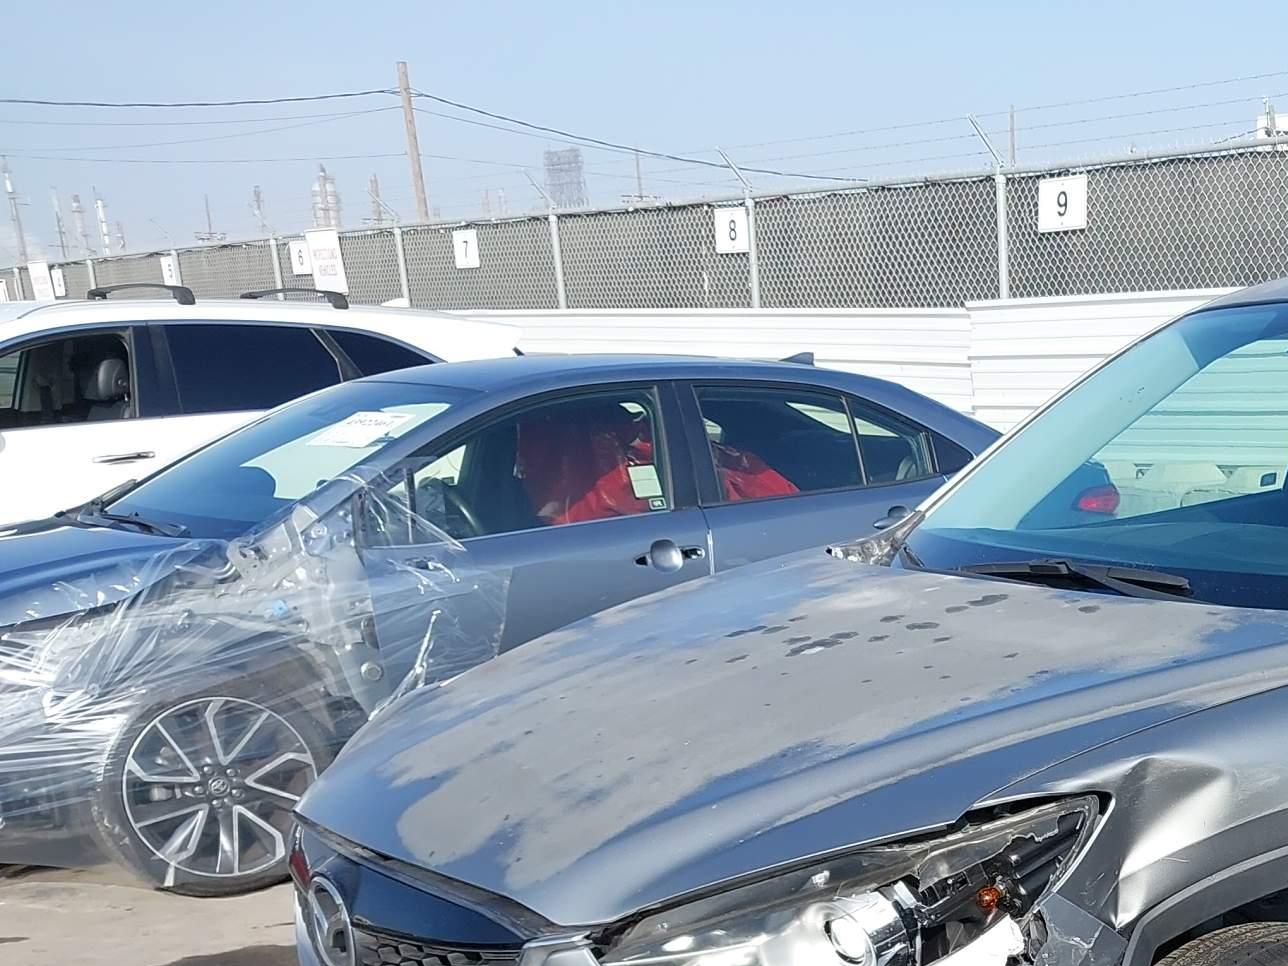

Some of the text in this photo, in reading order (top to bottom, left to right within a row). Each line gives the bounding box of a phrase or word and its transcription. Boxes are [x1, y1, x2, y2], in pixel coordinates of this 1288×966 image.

[1057, 191, 1068, 217] 9
[729, 219, 737, 241] 8
[298, 249, 304, 266] 6
[462, 240, 468, 258] 7
